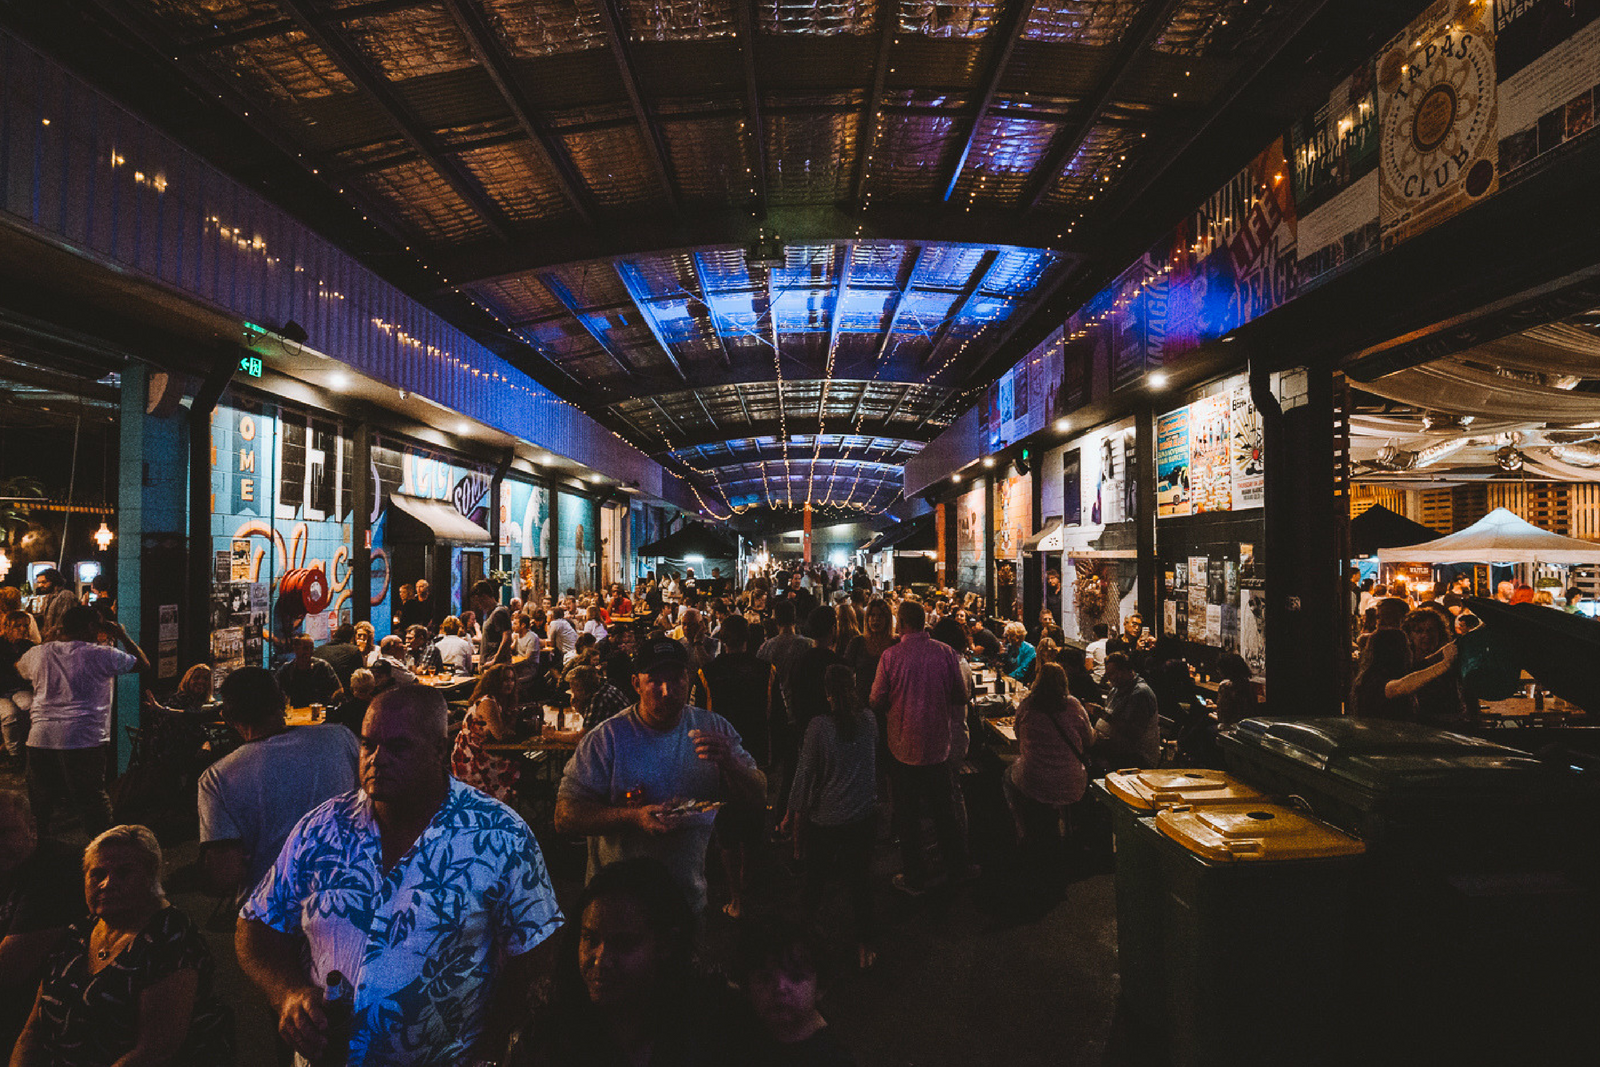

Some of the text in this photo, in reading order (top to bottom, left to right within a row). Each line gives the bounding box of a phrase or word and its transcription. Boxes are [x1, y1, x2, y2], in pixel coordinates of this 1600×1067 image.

[1497, 0, 1542, 31] EVEN
[1394, 35, 1473, 101] TAPAS
[1403, 145, 1469, 198] CLUB
